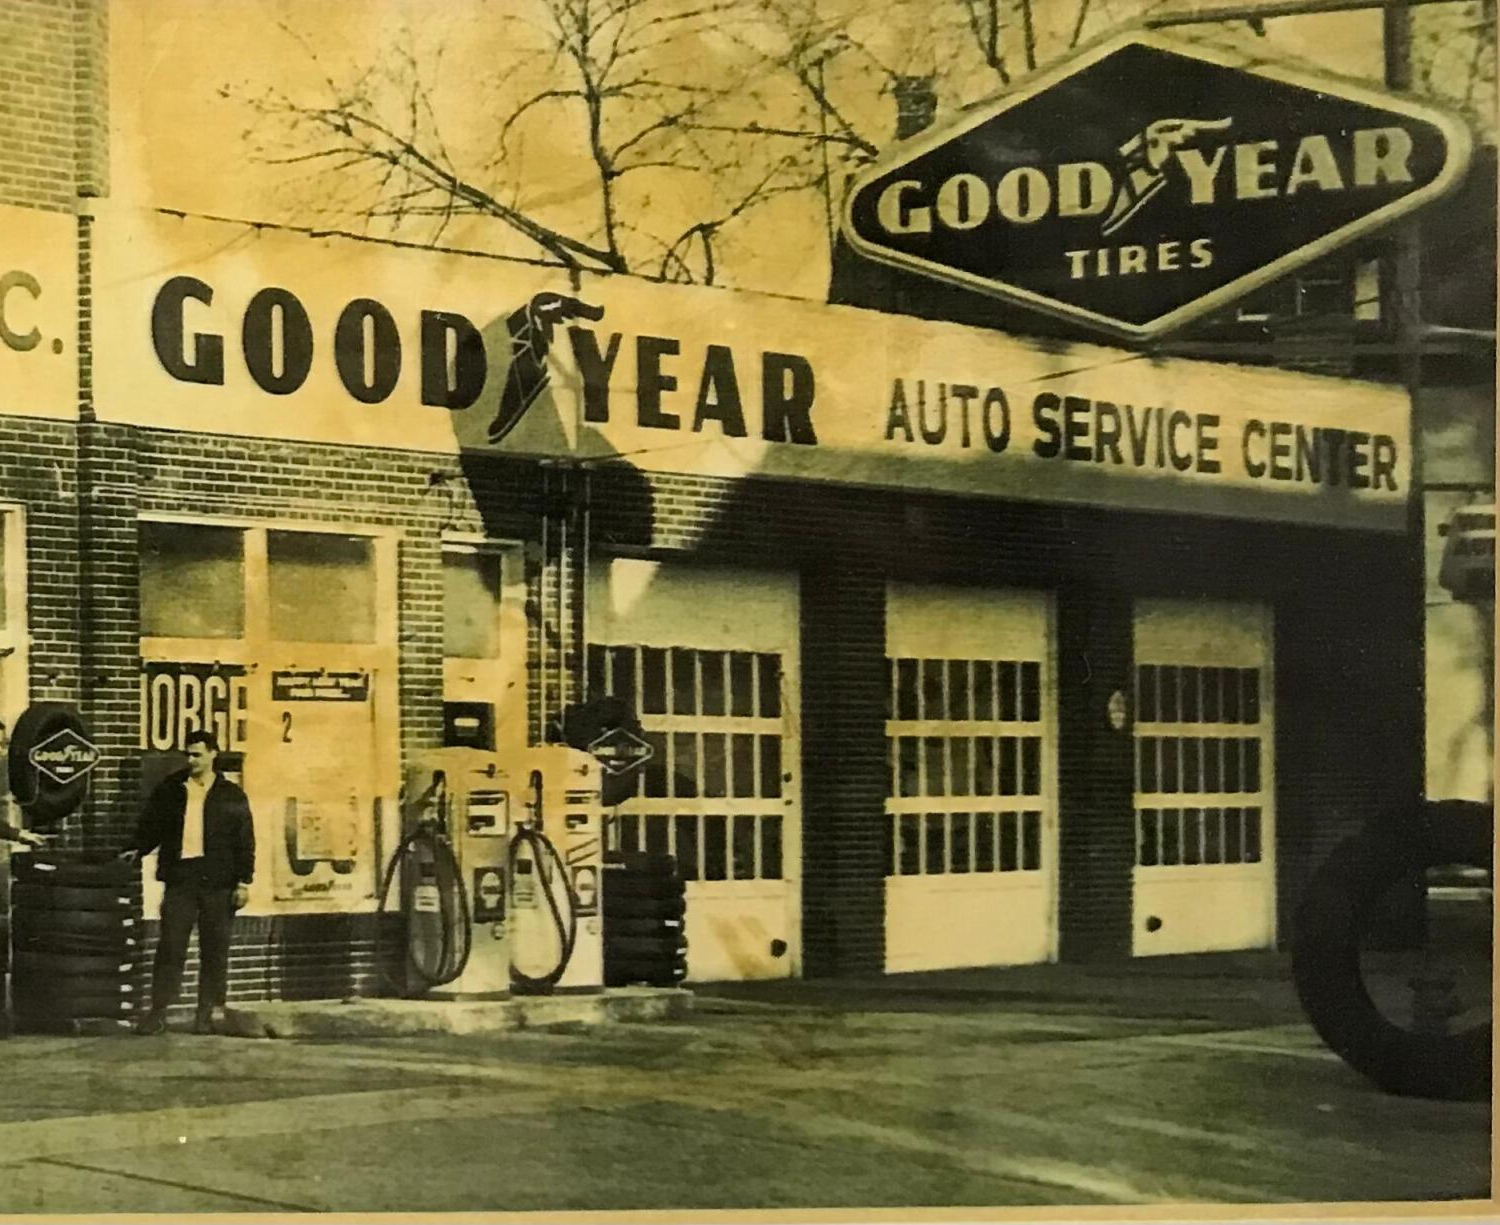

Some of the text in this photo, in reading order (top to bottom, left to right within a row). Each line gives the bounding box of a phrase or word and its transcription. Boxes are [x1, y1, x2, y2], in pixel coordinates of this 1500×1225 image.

[1065, 238, 1214, 280] TIRES
[151, 275, 817, 445] GOOD YEAR
[885, 378, 1399, 491] AUTO SERVICE CENTER
[282, 711, 293, 744] 2
